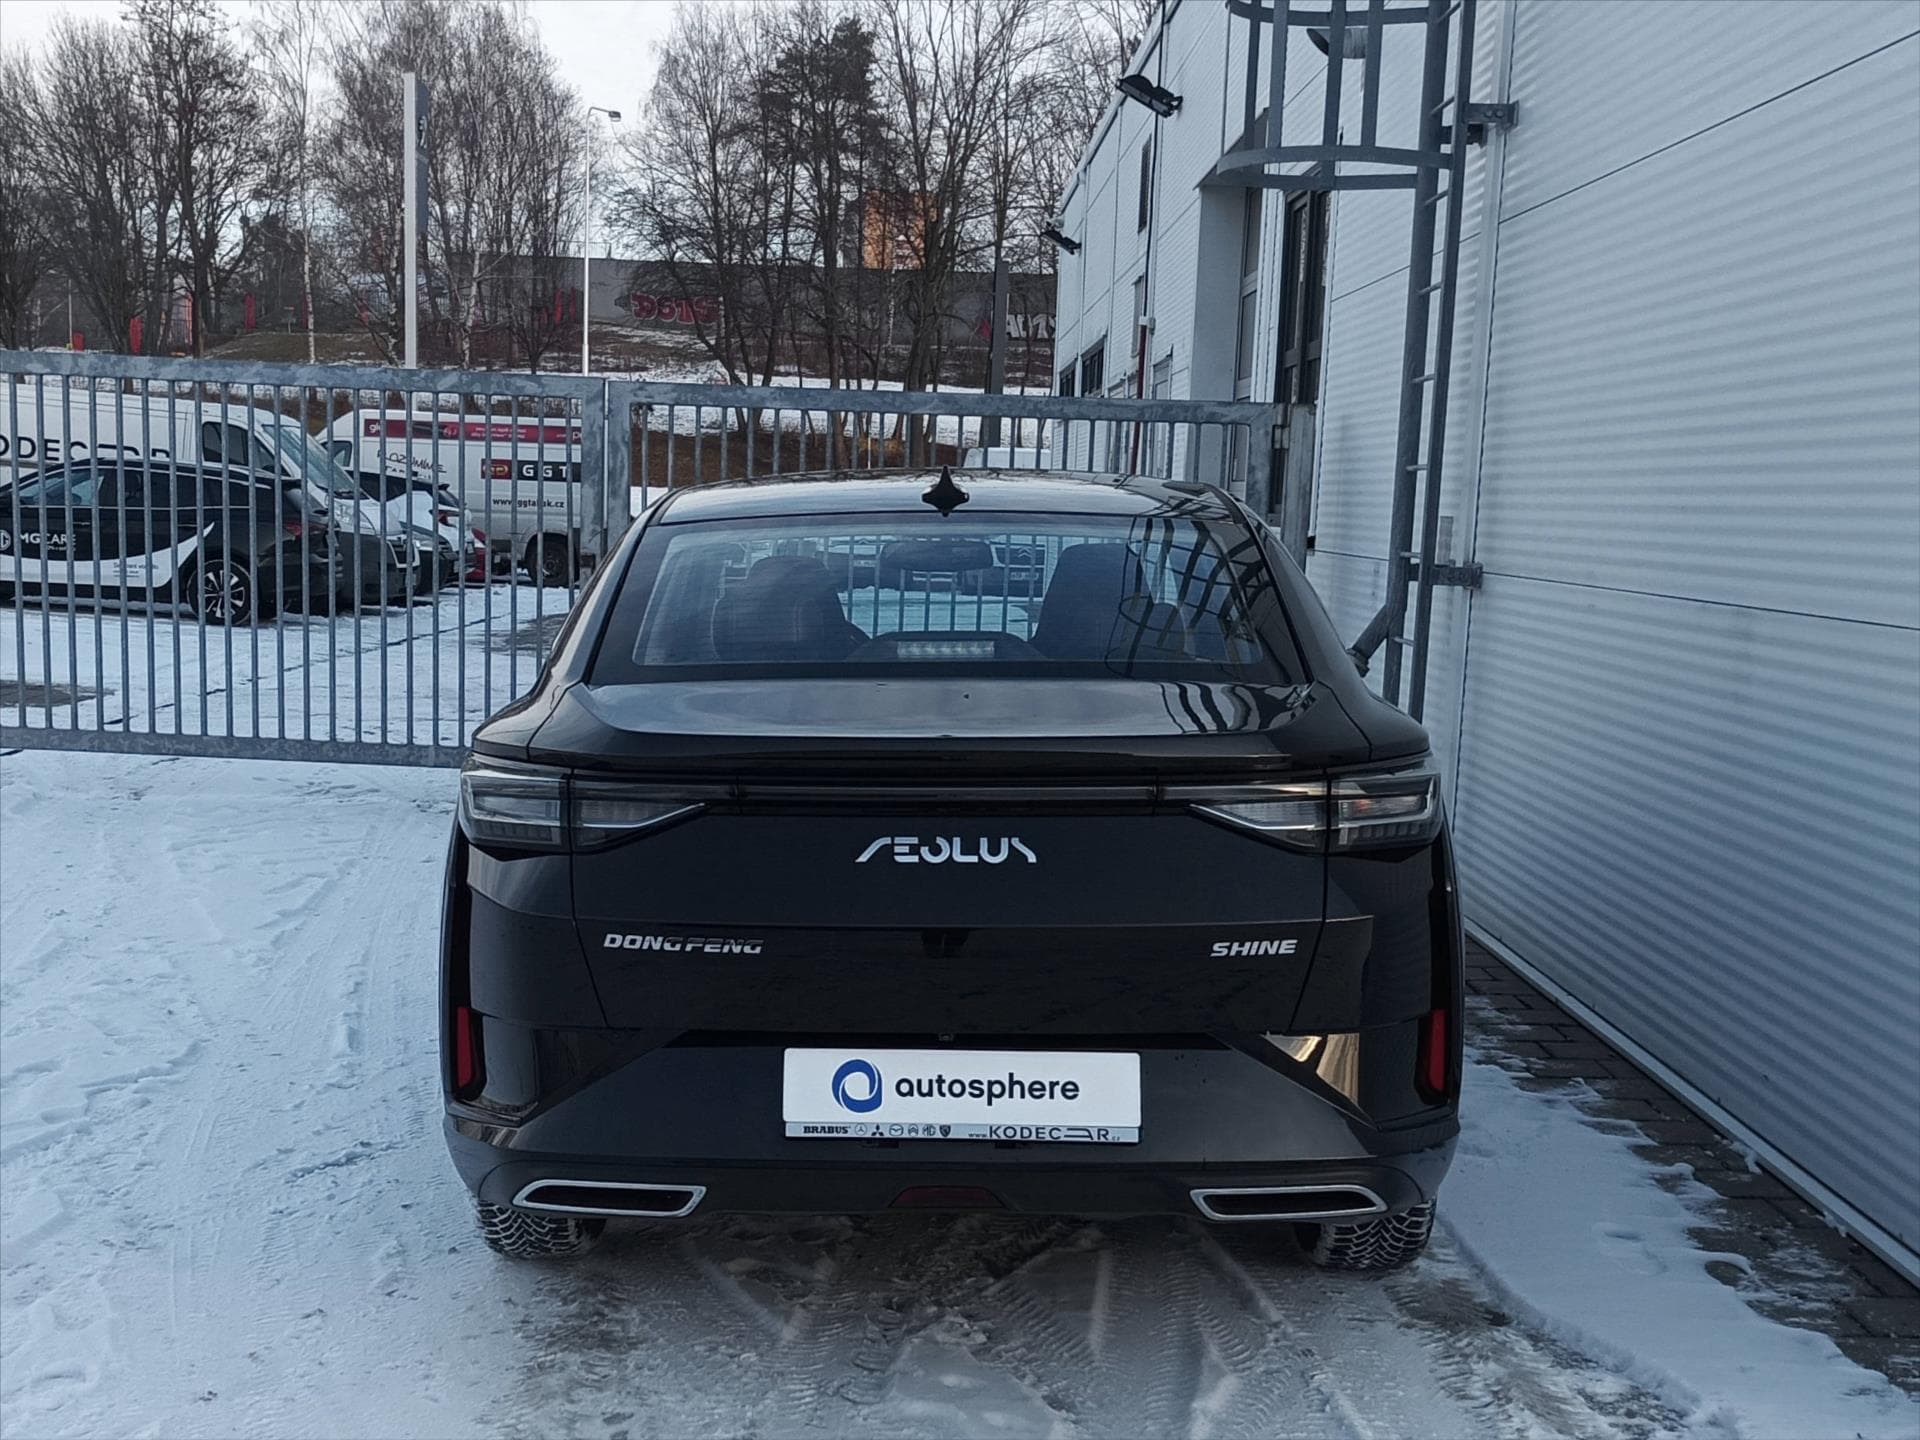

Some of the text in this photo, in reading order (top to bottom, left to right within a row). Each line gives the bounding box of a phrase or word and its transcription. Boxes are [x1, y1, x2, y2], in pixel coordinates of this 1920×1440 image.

[855, 836, 1037, 864] AEOLUS
[603, 933, 764, 954] DONGFENG
[1210, 939, 1298, 957] SHINE
[895, 1072, 1080, 1106] autosphere
[803, 1125, 849, 1134] BRABUS
